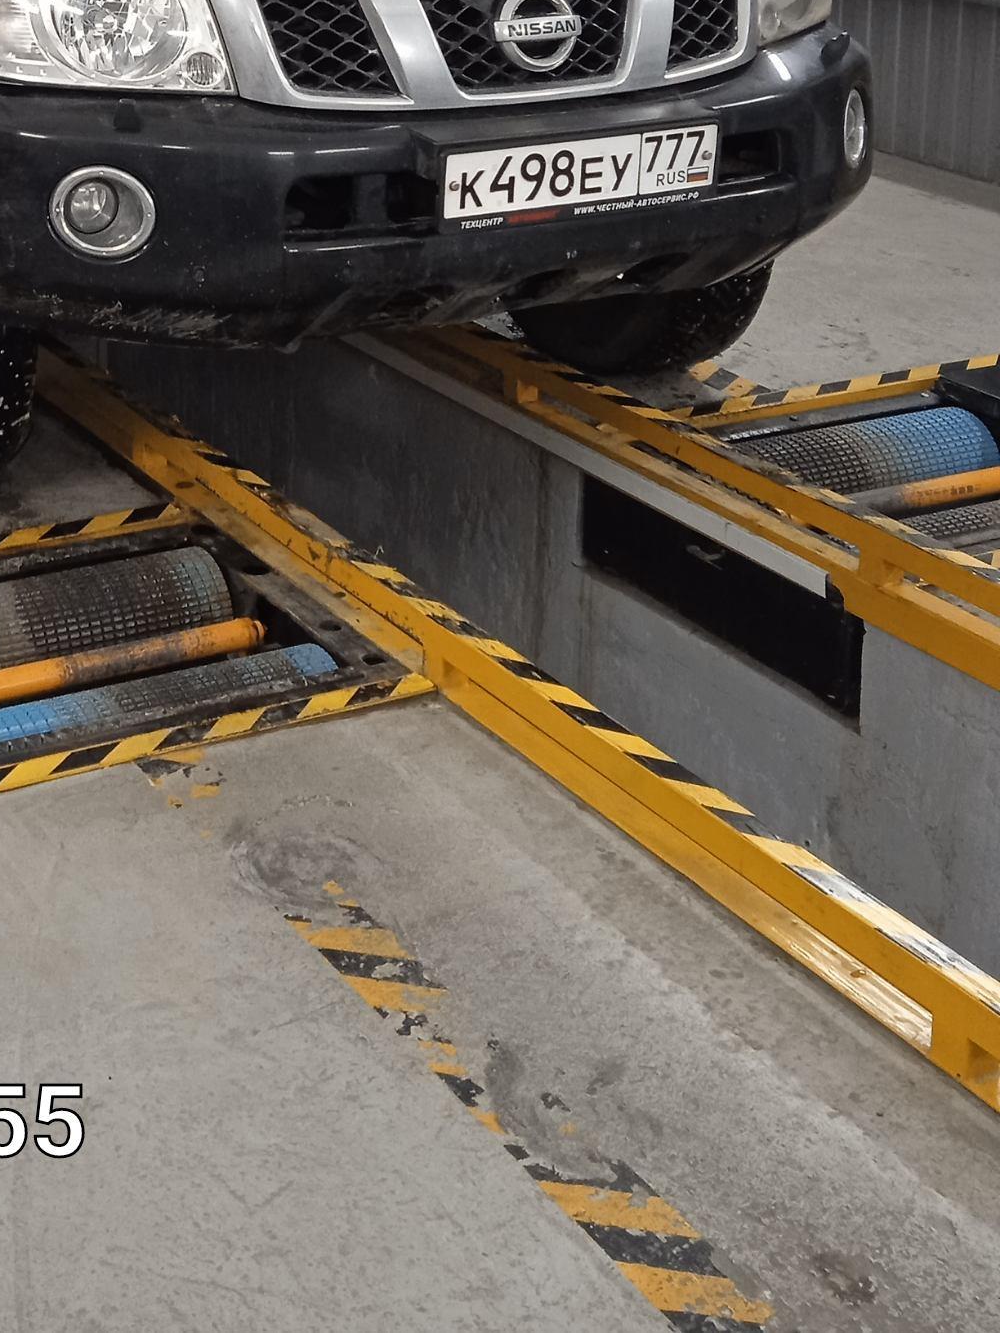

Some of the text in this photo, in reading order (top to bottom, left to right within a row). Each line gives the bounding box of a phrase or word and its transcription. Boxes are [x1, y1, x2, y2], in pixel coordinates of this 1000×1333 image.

[507, 19, 576, 37] NISSAN
[644, 130, 705, 173] 777
[656, 170, 686, 187] RUS
[460, 216, 504, 229] ТЕХЦЕНТР
